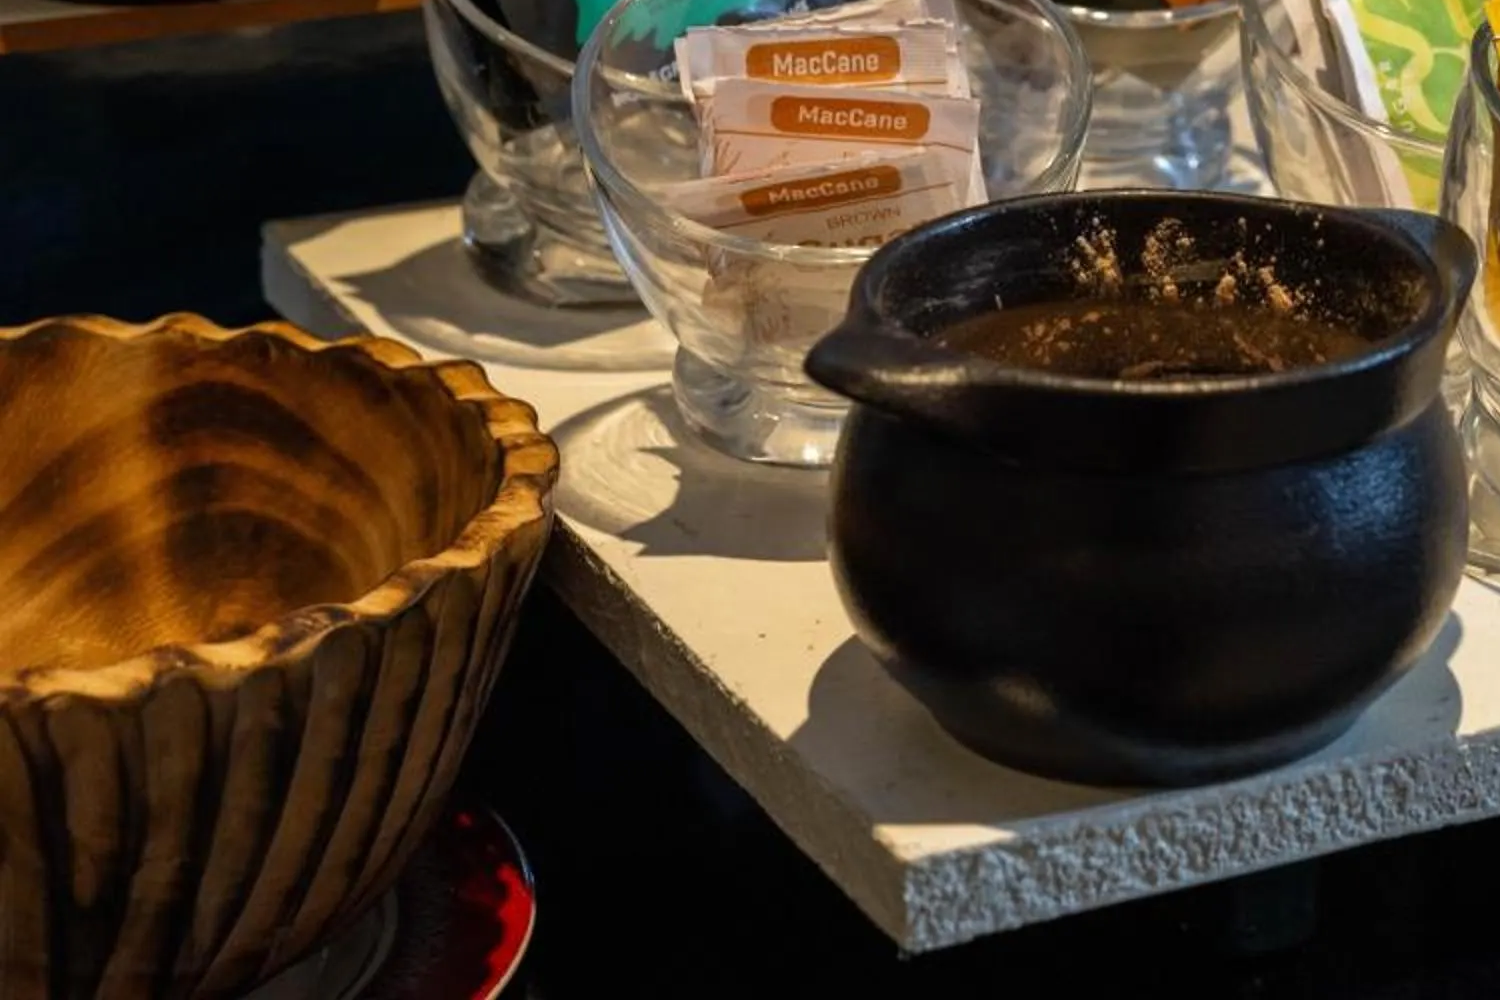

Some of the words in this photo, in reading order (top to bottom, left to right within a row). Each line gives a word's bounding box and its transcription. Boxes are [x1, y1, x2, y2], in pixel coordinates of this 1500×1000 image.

[772, 50, 880, 77] MacCane
[799, 104, 909, 131] MacCane
[768, 174, 880, 204] MacCane
[826, 207, 901, 226] BROWN
